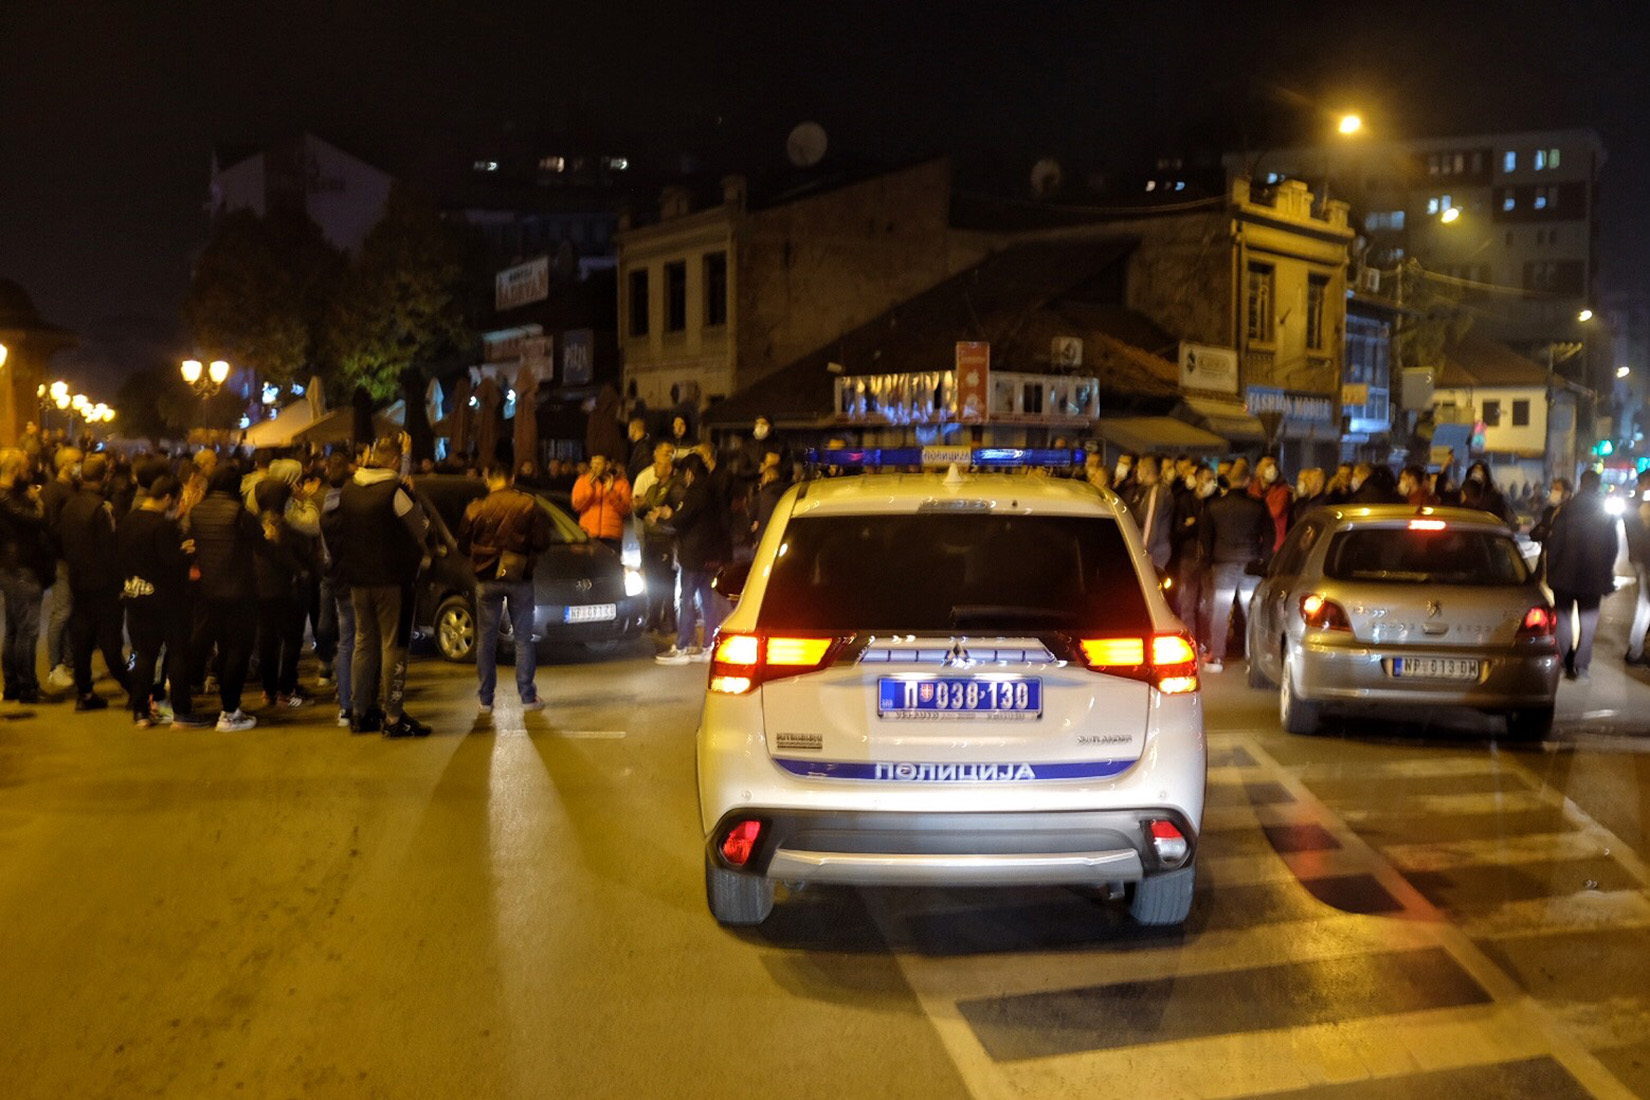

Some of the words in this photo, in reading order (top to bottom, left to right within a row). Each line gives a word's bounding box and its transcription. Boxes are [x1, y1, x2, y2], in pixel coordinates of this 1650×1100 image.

[1405, 658, 1421, 672] NP
[1431, 659, 1455, 674] 013
[874, 762, 1036, 781] ПОЛИЦИЈА
